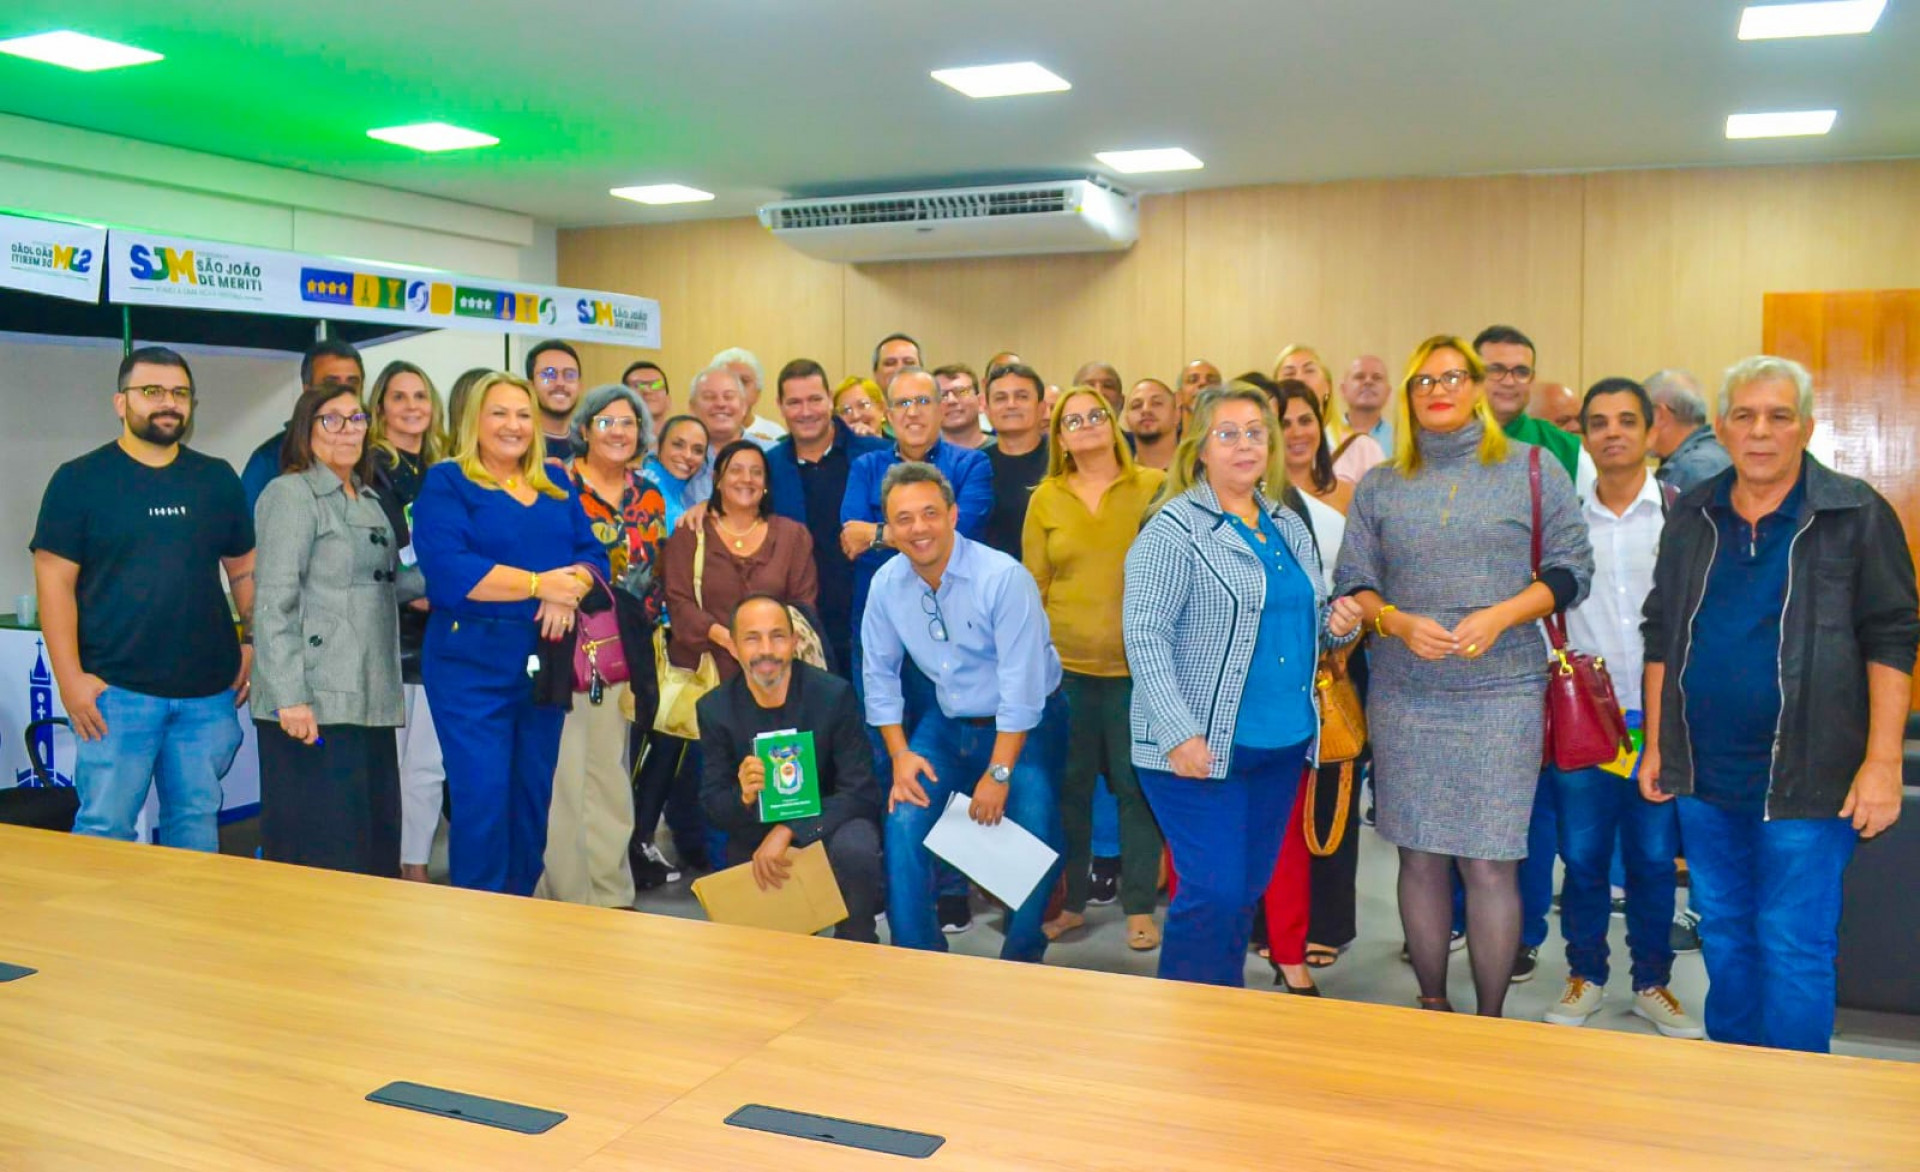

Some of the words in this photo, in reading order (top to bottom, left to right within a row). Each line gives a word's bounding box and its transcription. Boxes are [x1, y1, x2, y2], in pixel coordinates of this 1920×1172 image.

[130, 244, 198, 286] SJM
[196, 258, 223, 274] SÃO
[225, 261, 261, 278] JOÃO
[198, 273, 216, 287] DE
[217, 275, 263, 292] MERITI
[576, 298, 614, 327] SJM
